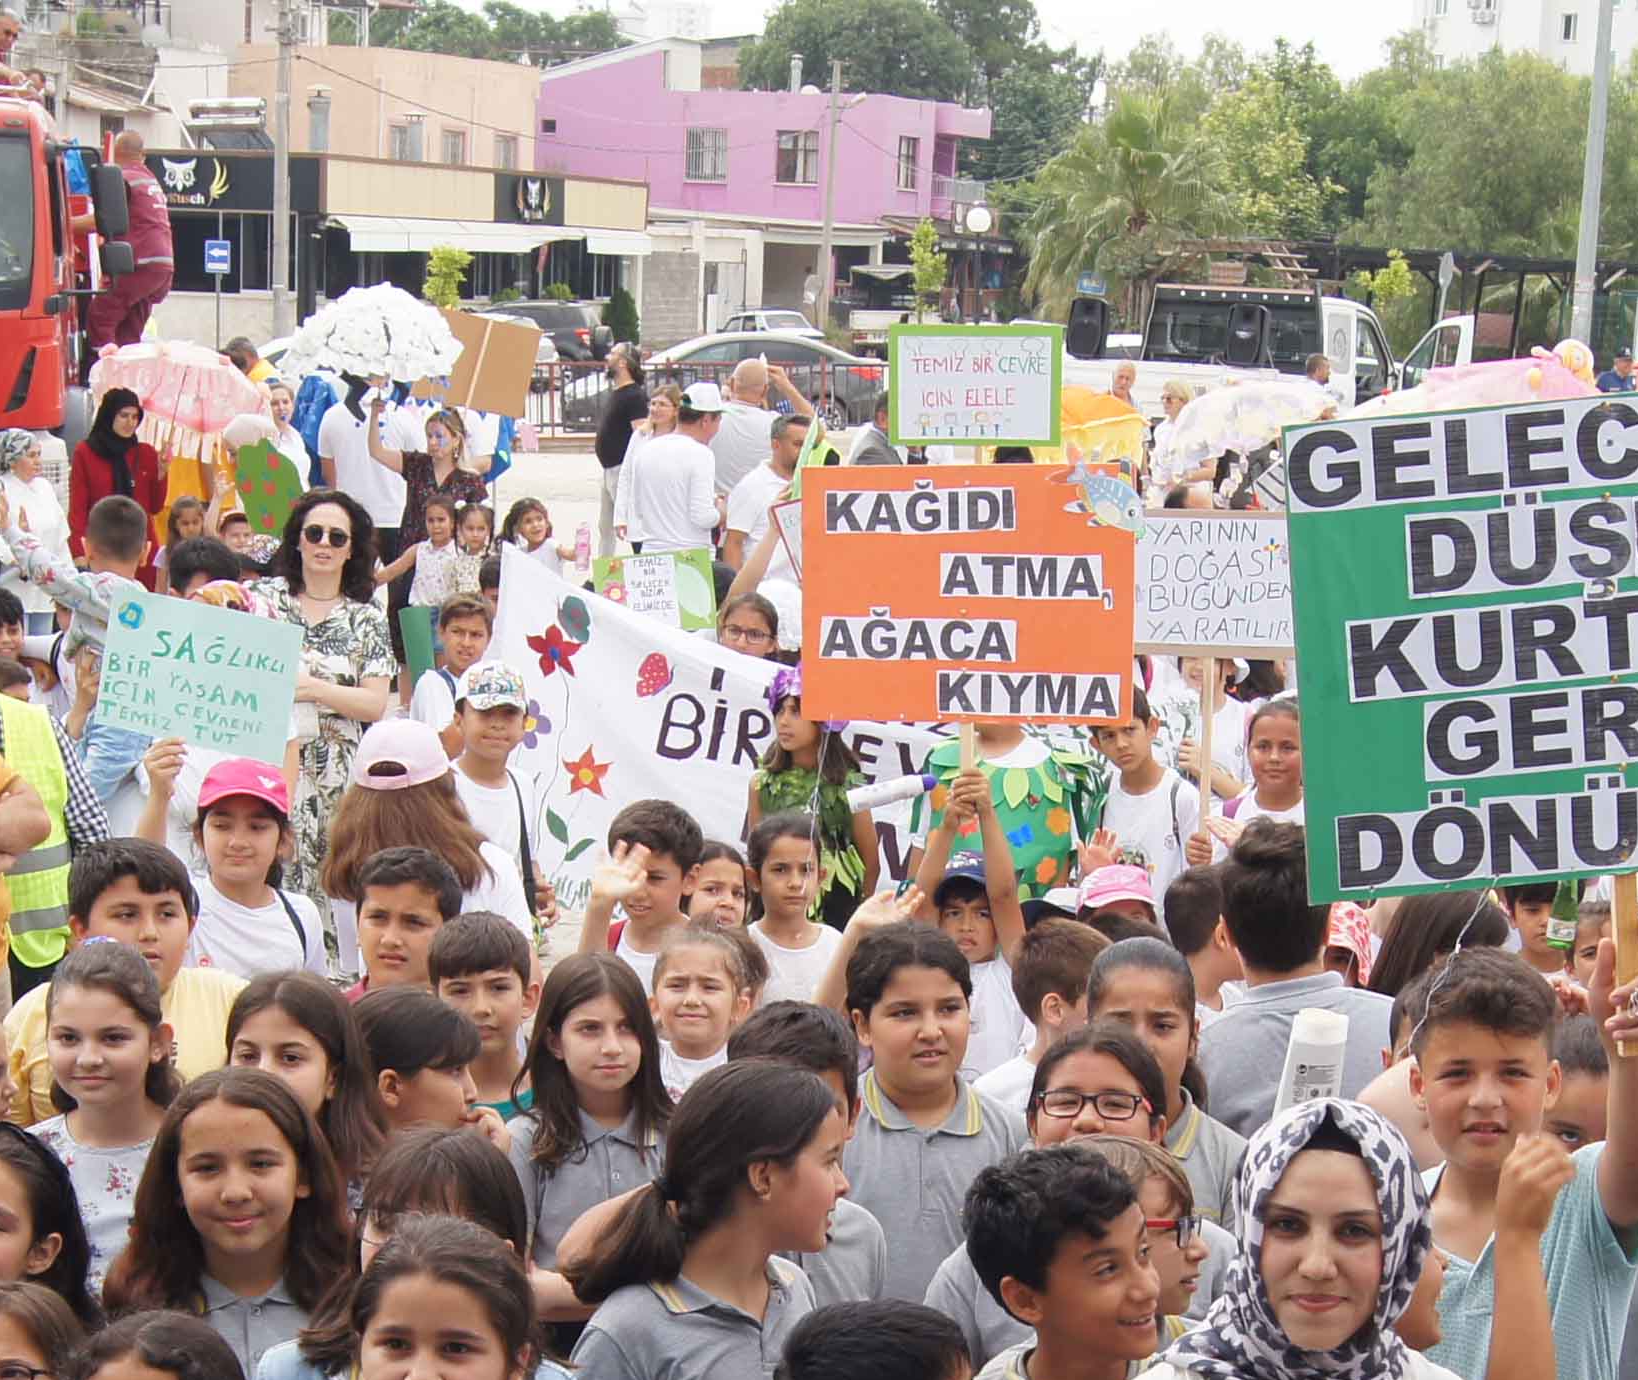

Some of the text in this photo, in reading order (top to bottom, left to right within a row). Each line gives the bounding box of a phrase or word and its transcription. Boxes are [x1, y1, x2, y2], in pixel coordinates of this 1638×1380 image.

[826, 480, 1014, 532] KAĞIDI
[151, 630, 284, 673] SAĞLIKLI
[821, 608, 1013, 661] AĞACA
[107, 652, 151, 677] BİR
[938, 673, 1118, 717] KIYMA
[194, 724, 237, 744] TUT
